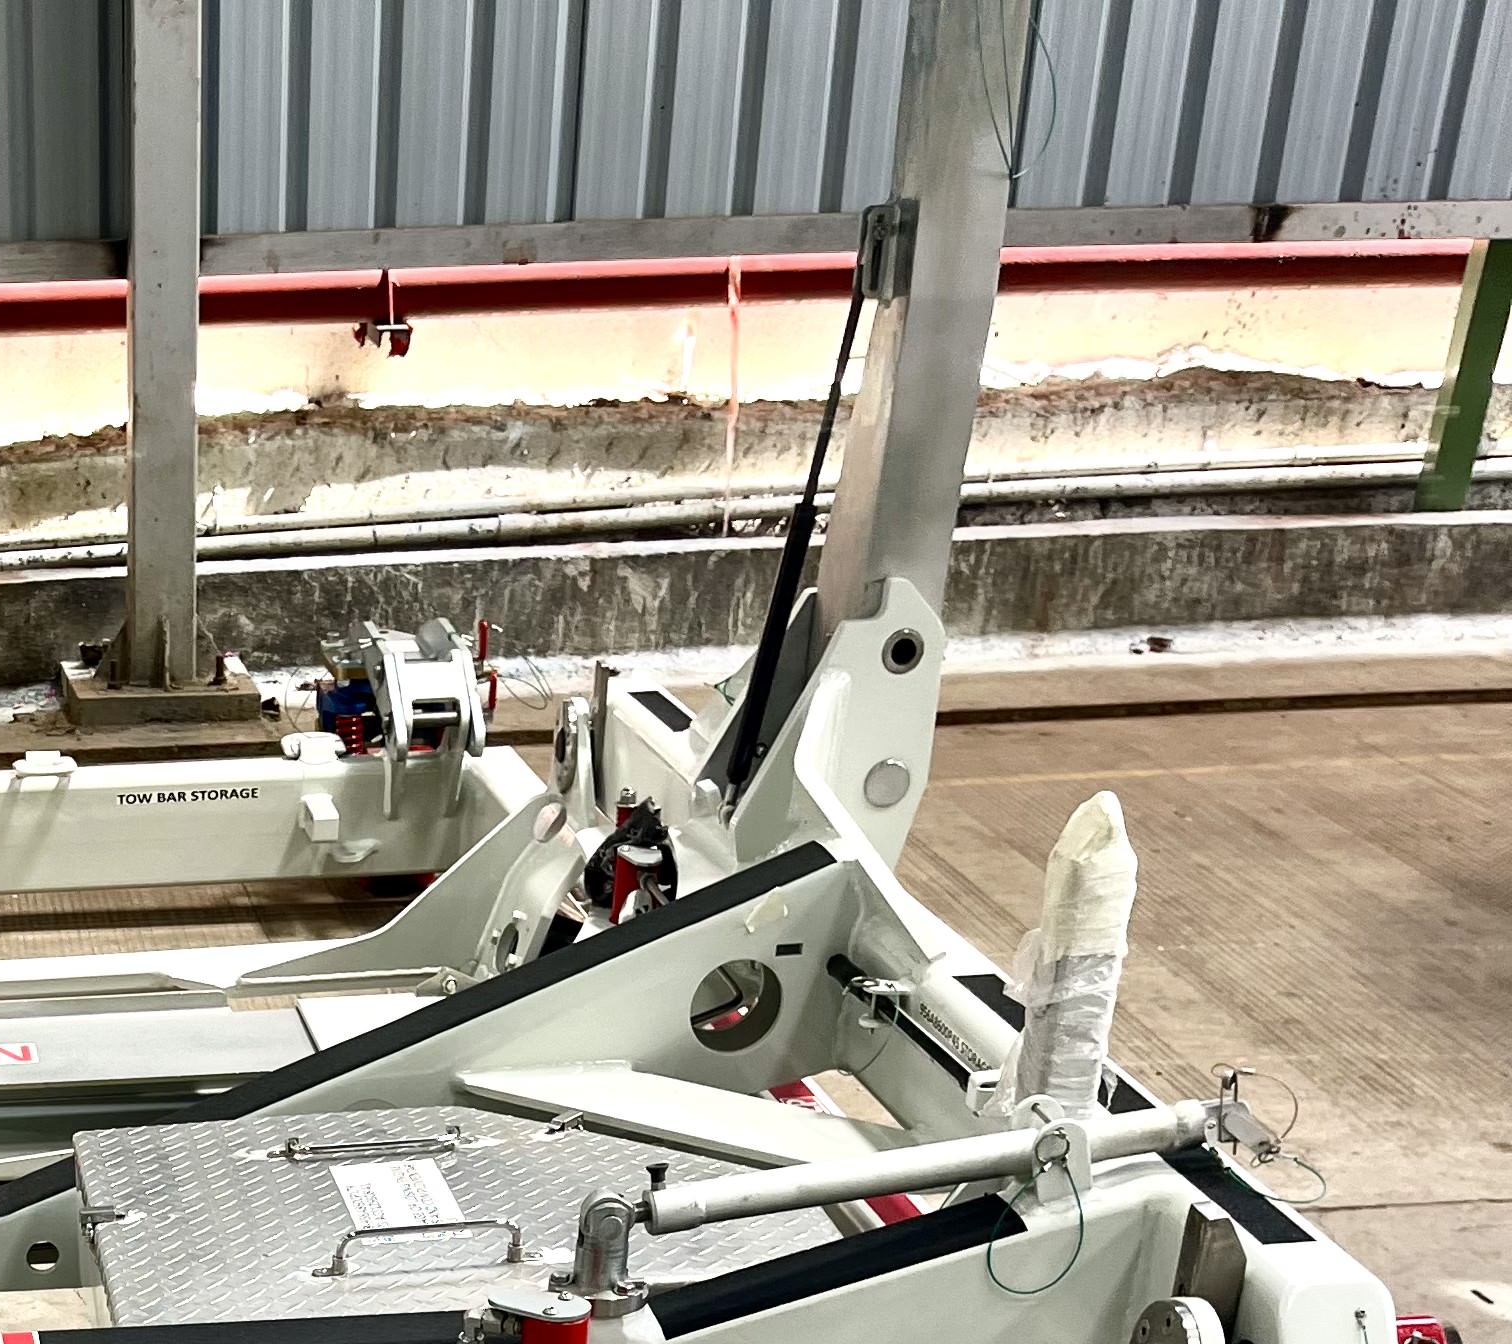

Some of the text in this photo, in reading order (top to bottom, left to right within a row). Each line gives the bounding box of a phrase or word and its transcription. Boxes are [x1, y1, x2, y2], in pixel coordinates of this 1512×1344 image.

[117, 788, 258, 805] TOW BAR STORAGE
